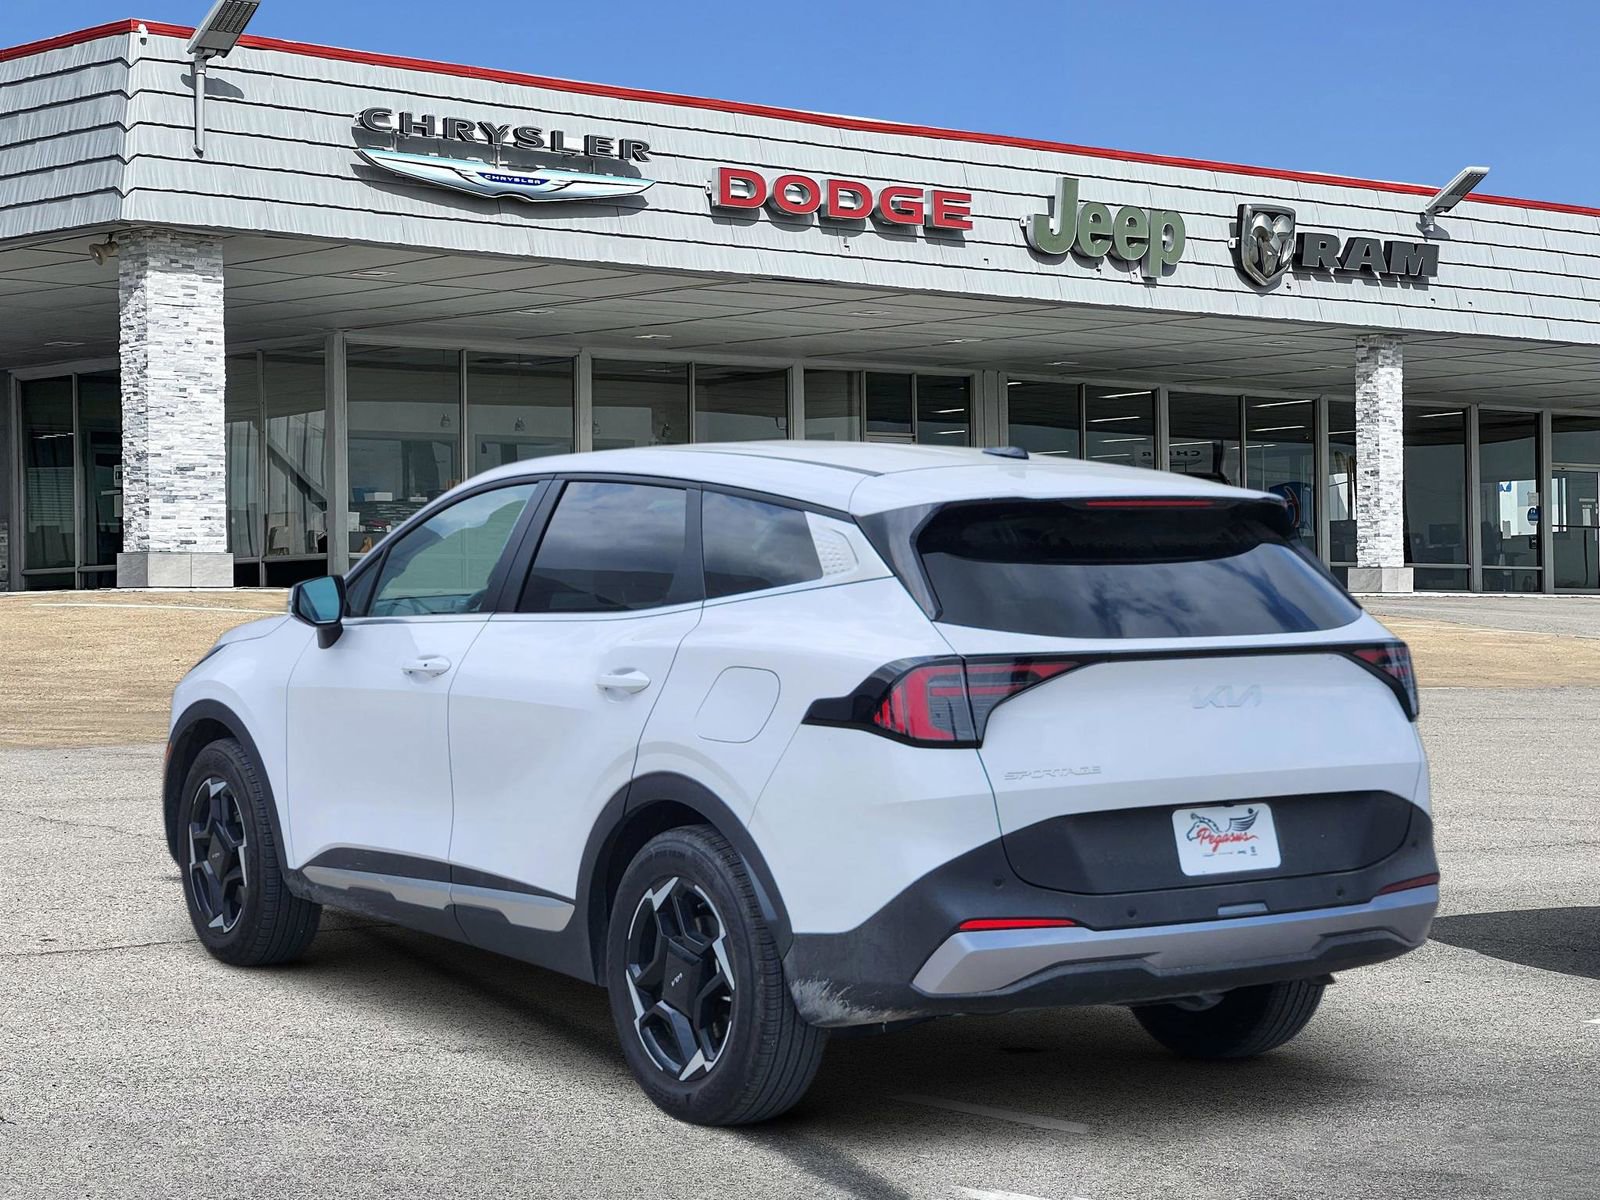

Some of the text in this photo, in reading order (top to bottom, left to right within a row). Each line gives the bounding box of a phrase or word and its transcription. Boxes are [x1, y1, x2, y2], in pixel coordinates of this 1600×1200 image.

[358, 106, 652, 162] CHRYSLER
[484, 174, 541, 185] CHRYSLER
[711, 166, 974, 231] DODGE
[1026, 176, 1187, 278] Jeep
[1294, 232, 1440, 277] RAM
[1004, 765, 1102, 780] SPORTAGE
